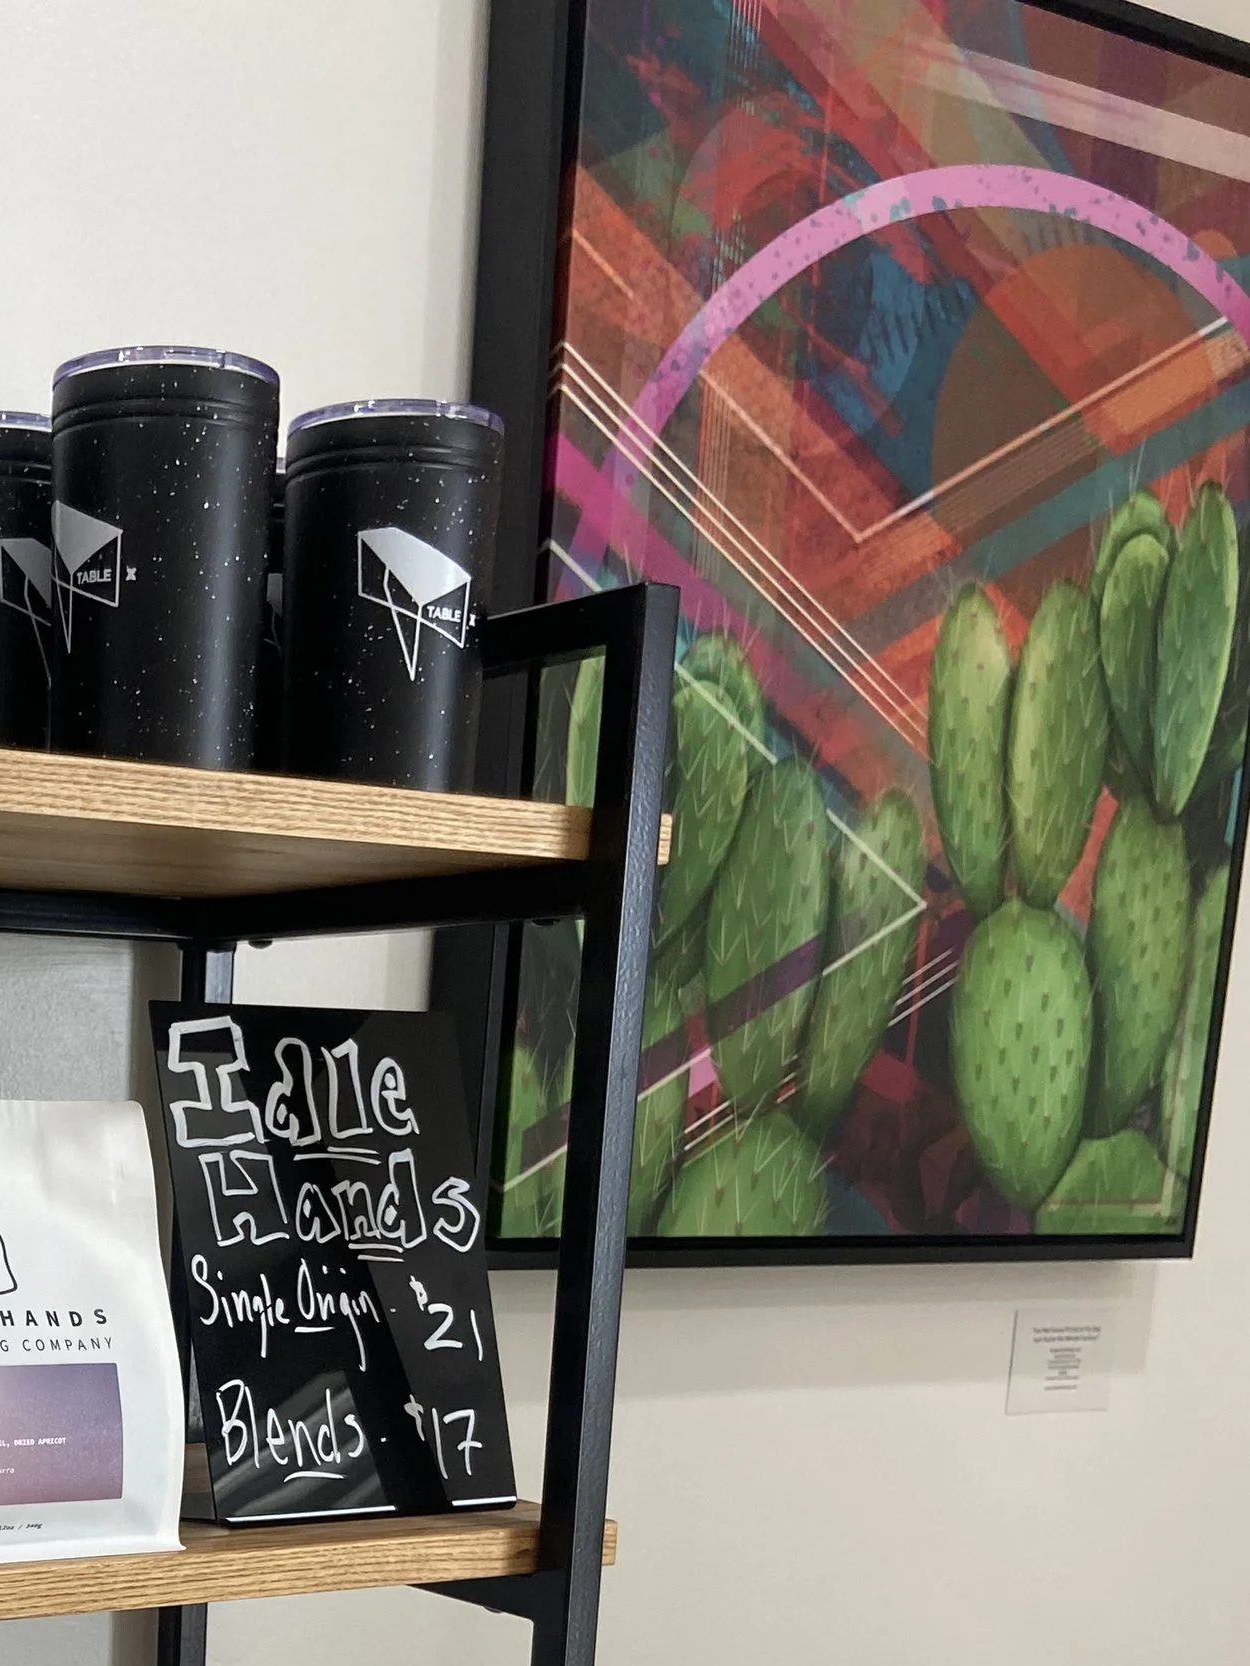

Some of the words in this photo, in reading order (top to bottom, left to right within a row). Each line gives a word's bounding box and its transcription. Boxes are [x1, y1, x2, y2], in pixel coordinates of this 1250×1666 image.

[76, 569, 111, 585] TABLE
[125, 565, 136, 581] X
[427, 606, 461, 623] TABLE
[168, 1016, 420, 1147] Idle
[199, 1147, 481, 1253] Hands
[191, 1254, 290, 1357] Single
[0, 1308, 108, 1327] HANDS
[22, 1337, 113, 1351] COMPANY
[38, 1437, 67, 1445] APRICOT
